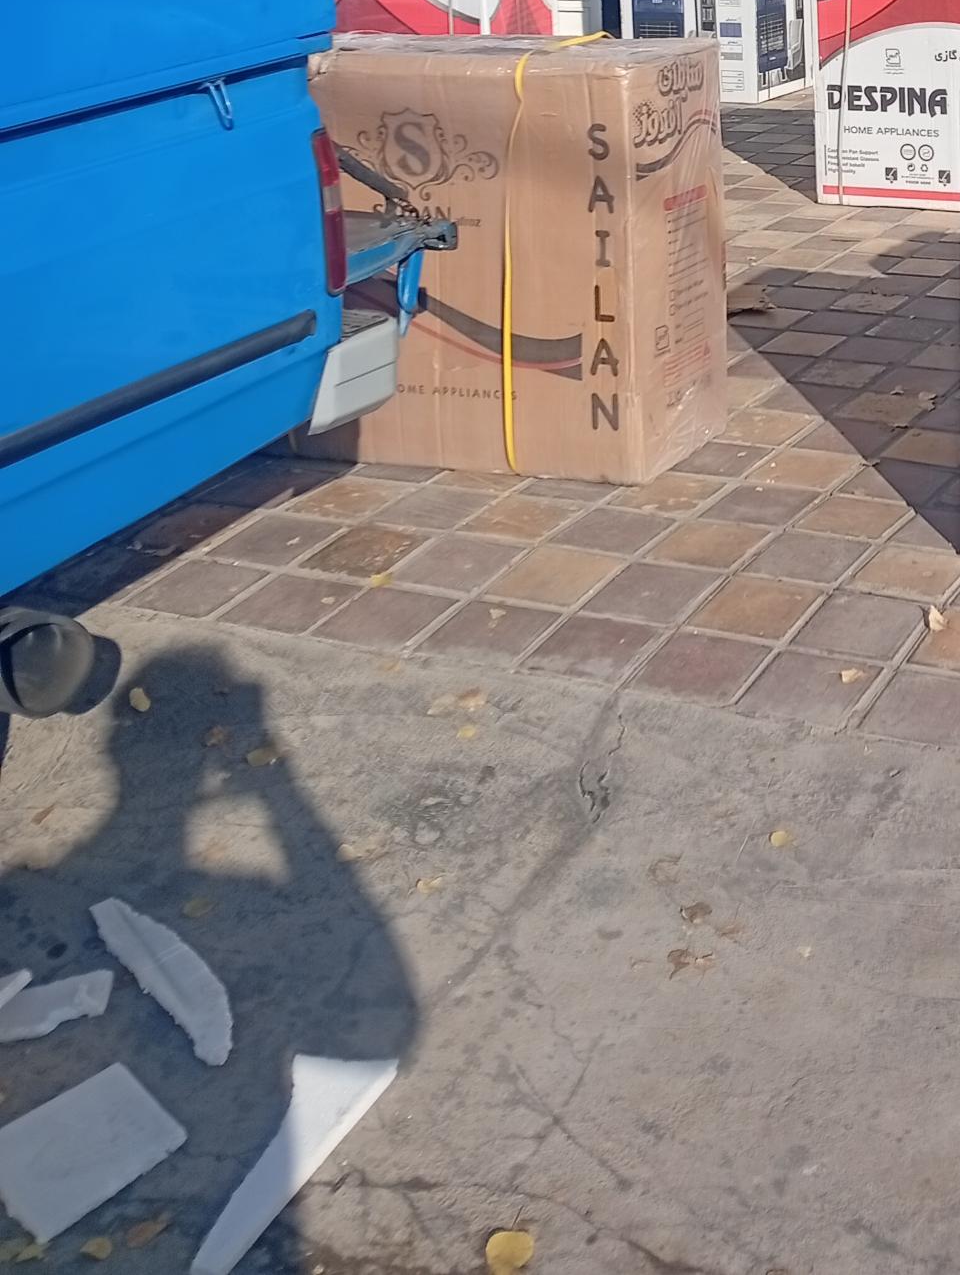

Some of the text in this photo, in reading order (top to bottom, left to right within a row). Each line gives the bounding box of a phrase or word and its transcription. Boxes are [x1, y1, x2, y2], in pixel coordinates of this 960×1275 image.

[934, 50, 957, 62] گازی
[826, 84, 948, 118] DESPINA
[844, 125, 940, 138] HOME APPLIANCES
[588, 123, 620, 431] SAILAN
[396, 383, 517, 401] OME APPLIANCS
